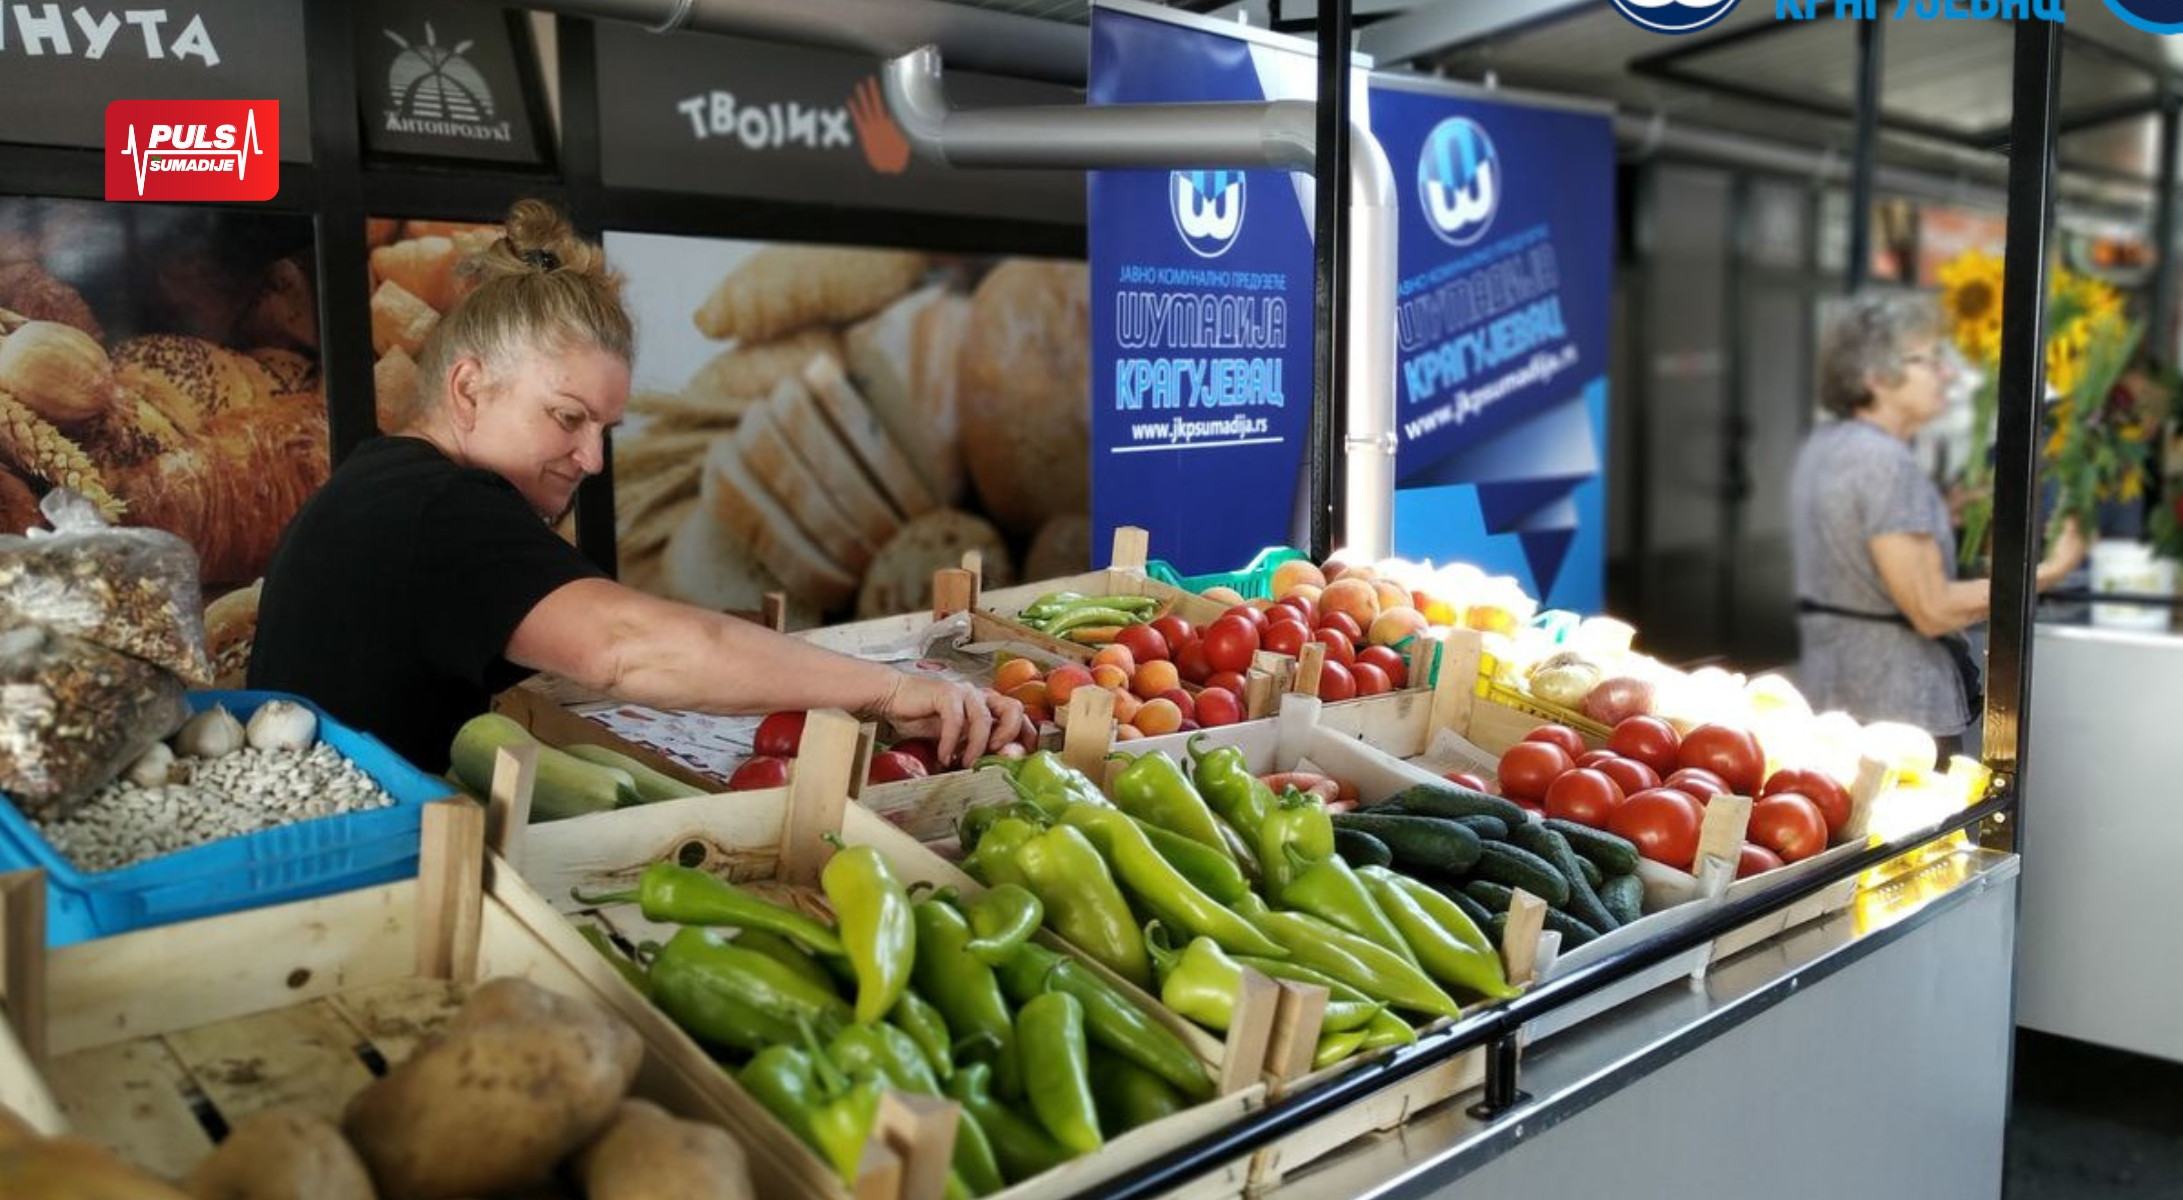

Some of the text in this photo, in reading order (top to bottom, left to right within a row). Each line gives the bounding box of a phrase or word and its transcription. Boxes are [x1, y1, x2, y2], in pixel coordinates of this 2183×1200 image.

[0, 3, 221, 68] НУТА
[1116, 291, 1287, 348] ШУМАДИЈА
[1116, 358, 1285, 410] КРАГУЈЕВАЦ
[1132, 414, 1268, 443] www.jkpsumadija.rs
